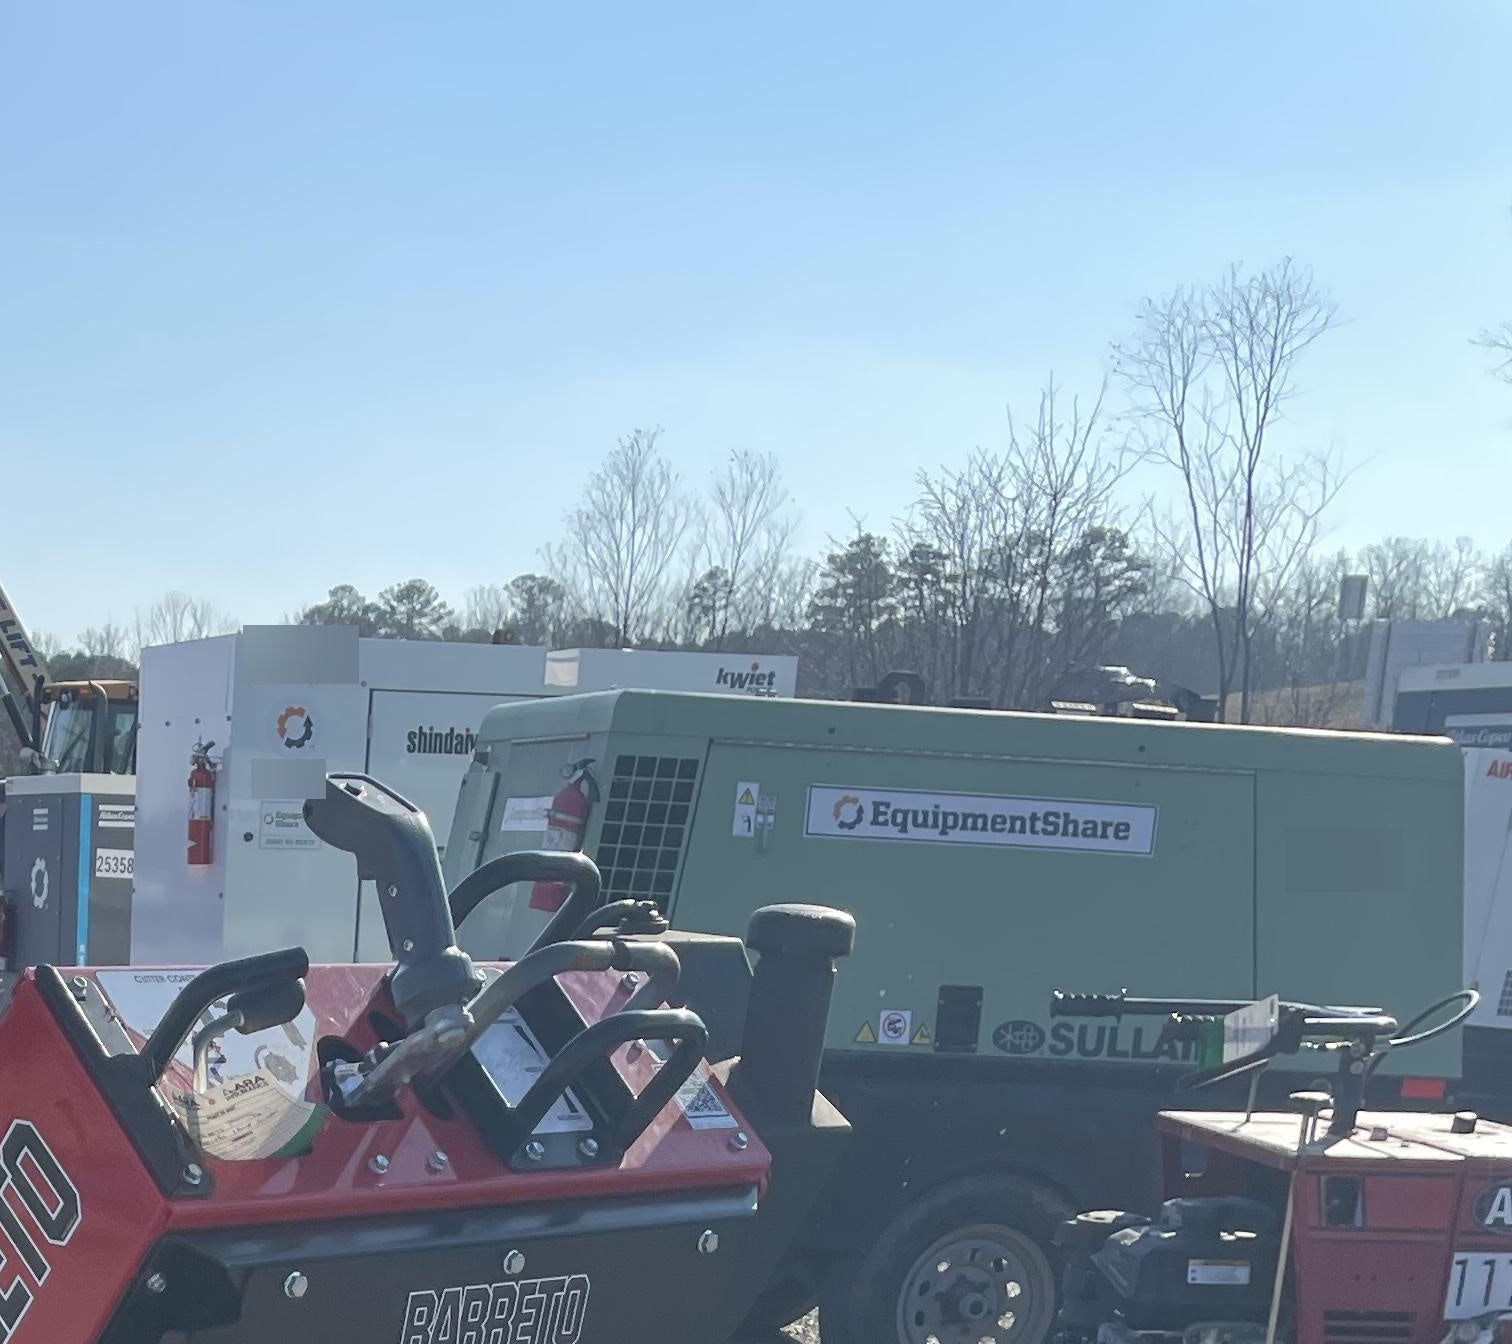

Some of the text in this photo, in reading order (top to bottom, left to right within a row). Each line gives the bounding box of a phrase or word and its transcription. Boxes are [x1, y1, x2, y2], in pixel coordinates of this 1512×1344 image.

[0, 619, 39, 668] LIFT
[716, 662, 776, 689] kwiet
[870, 800, 1131, 841] EquipmentShare
